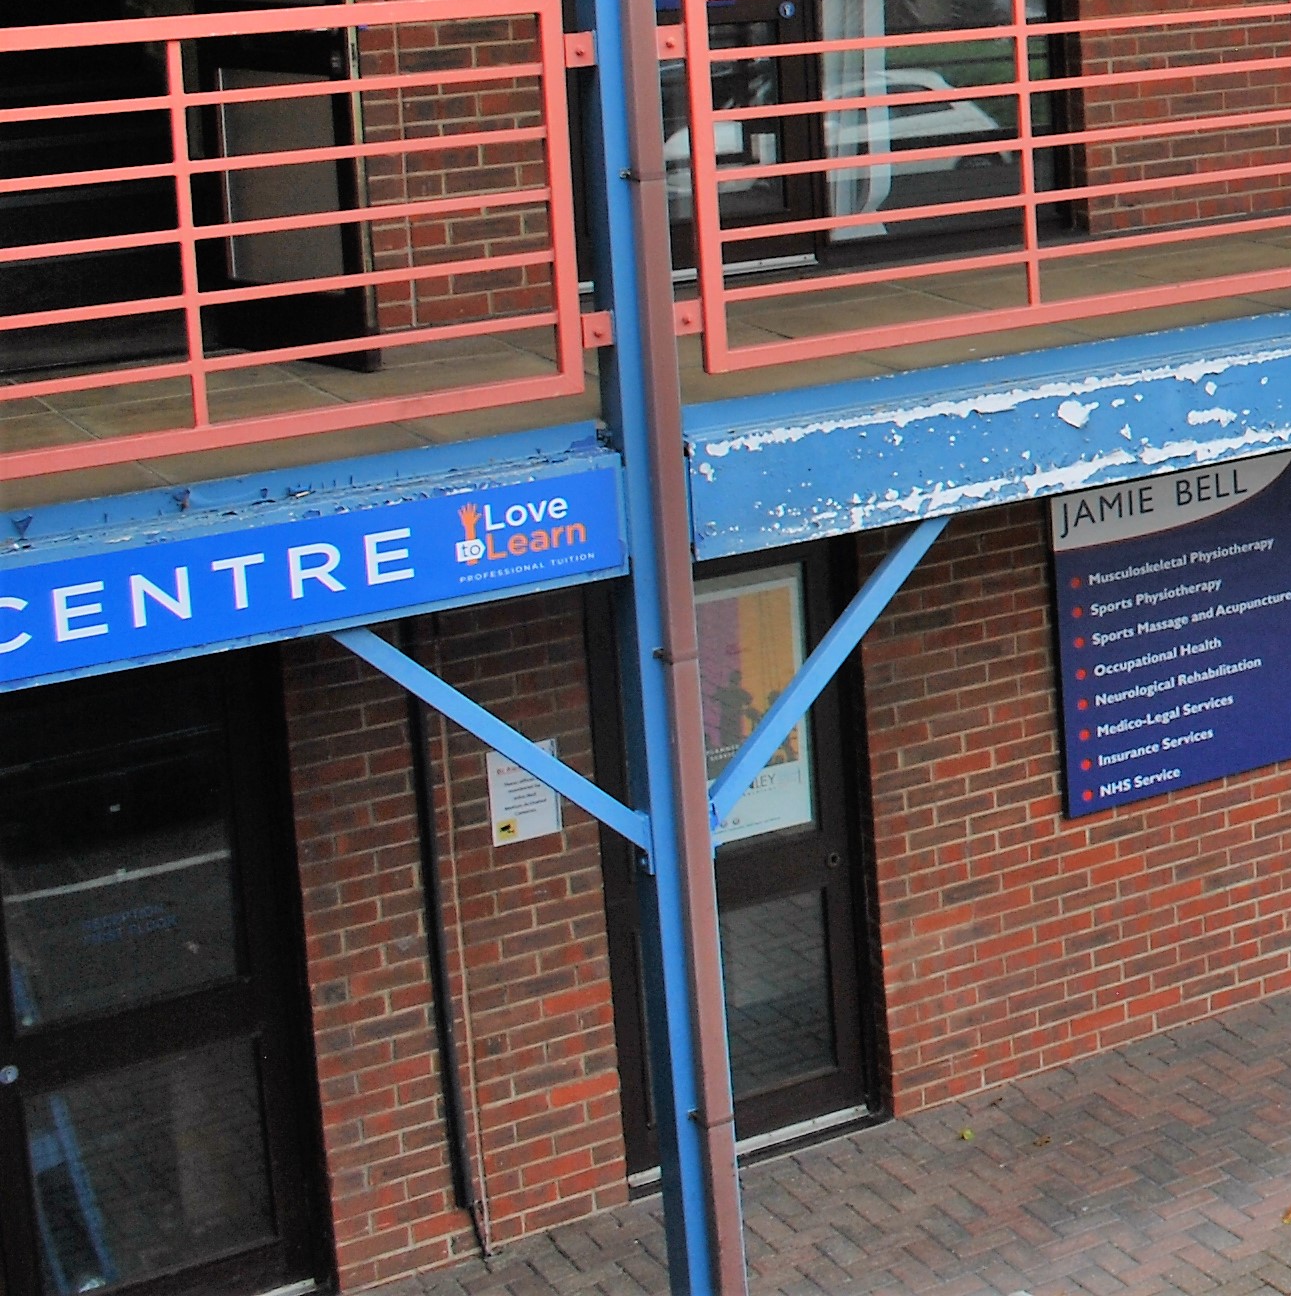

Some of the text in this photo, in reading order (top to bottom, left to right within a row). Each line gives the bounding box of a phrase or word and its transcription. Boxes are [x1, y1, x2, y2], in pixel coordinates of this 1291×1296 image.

[483, 497, 568, 531] Love
[1060, 469, 1248, 538] JAMIE BELL
[462, 522, 587, 560] to Learn
[1088, 537, 1275, 585] Musculoskeletal Physiotherapy
[460, 552, 595, 583] PROFESSIONAL TUITION
[0, 528, 415, 654] CENTRE
[1090, 577, 1222, 618] Sports Physiotherapy
[1091, 623, 1135, 647] Sports
[1137, 613, 1189, 636] Massage
[1191, 606, 1214, 623] and
[1094, 637, 1222, 678] Occupational Health
[1094, 656, 1263, 707] Neurological Rehabilitation
[1096, 693, 1235, 738] Medico-Legal Services
[1098, 728, 1214, 767] Insurance Services
[1100, 767, 1181, 798] NHS Service
